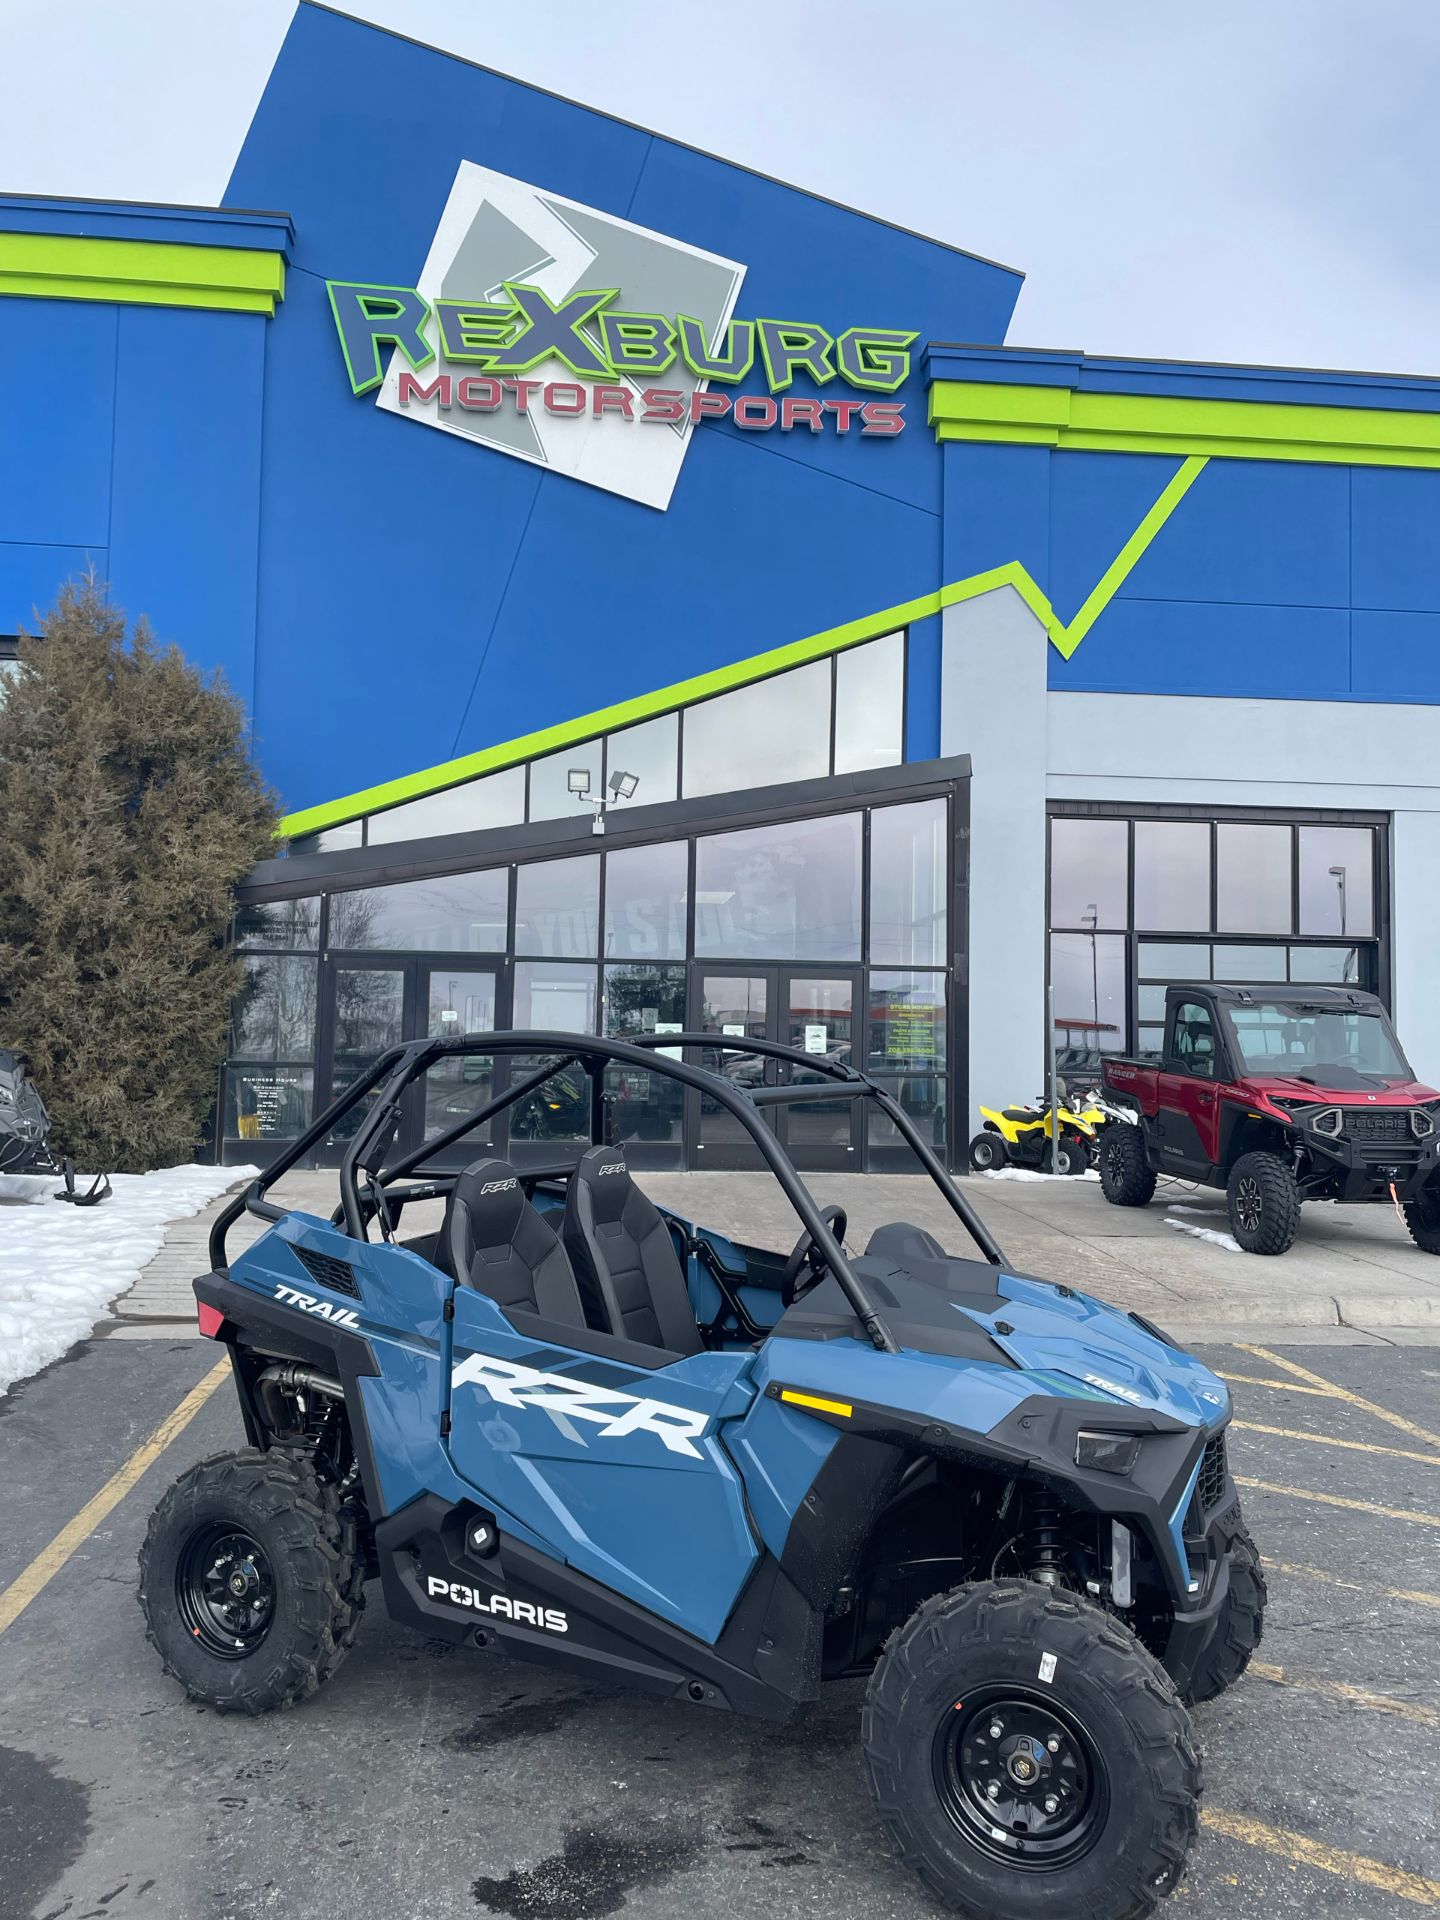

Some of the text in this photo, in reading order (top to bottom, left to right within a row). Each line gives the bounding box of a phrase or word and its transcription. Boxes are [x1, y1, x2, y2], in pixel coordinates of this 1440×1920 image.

[326, 281, 921, 397] REXBURG
[398, 373, 906, 437] MOTORSPORTS
[1108, 1068, 1137, 1080] RANGER
[1345, 1119, 1407, 1129] POLARIS
[481, 1178, 517, 1195] RZR
[598, 1163, 626, 1176] RZR
[273, 1284, 362, 1329] TRAIL
[451, 1352, 710, 1460] RZR
[1083, 1373, 1142, 1403] TRAIL
[427, 1576, 569, 1633] POLARIS
